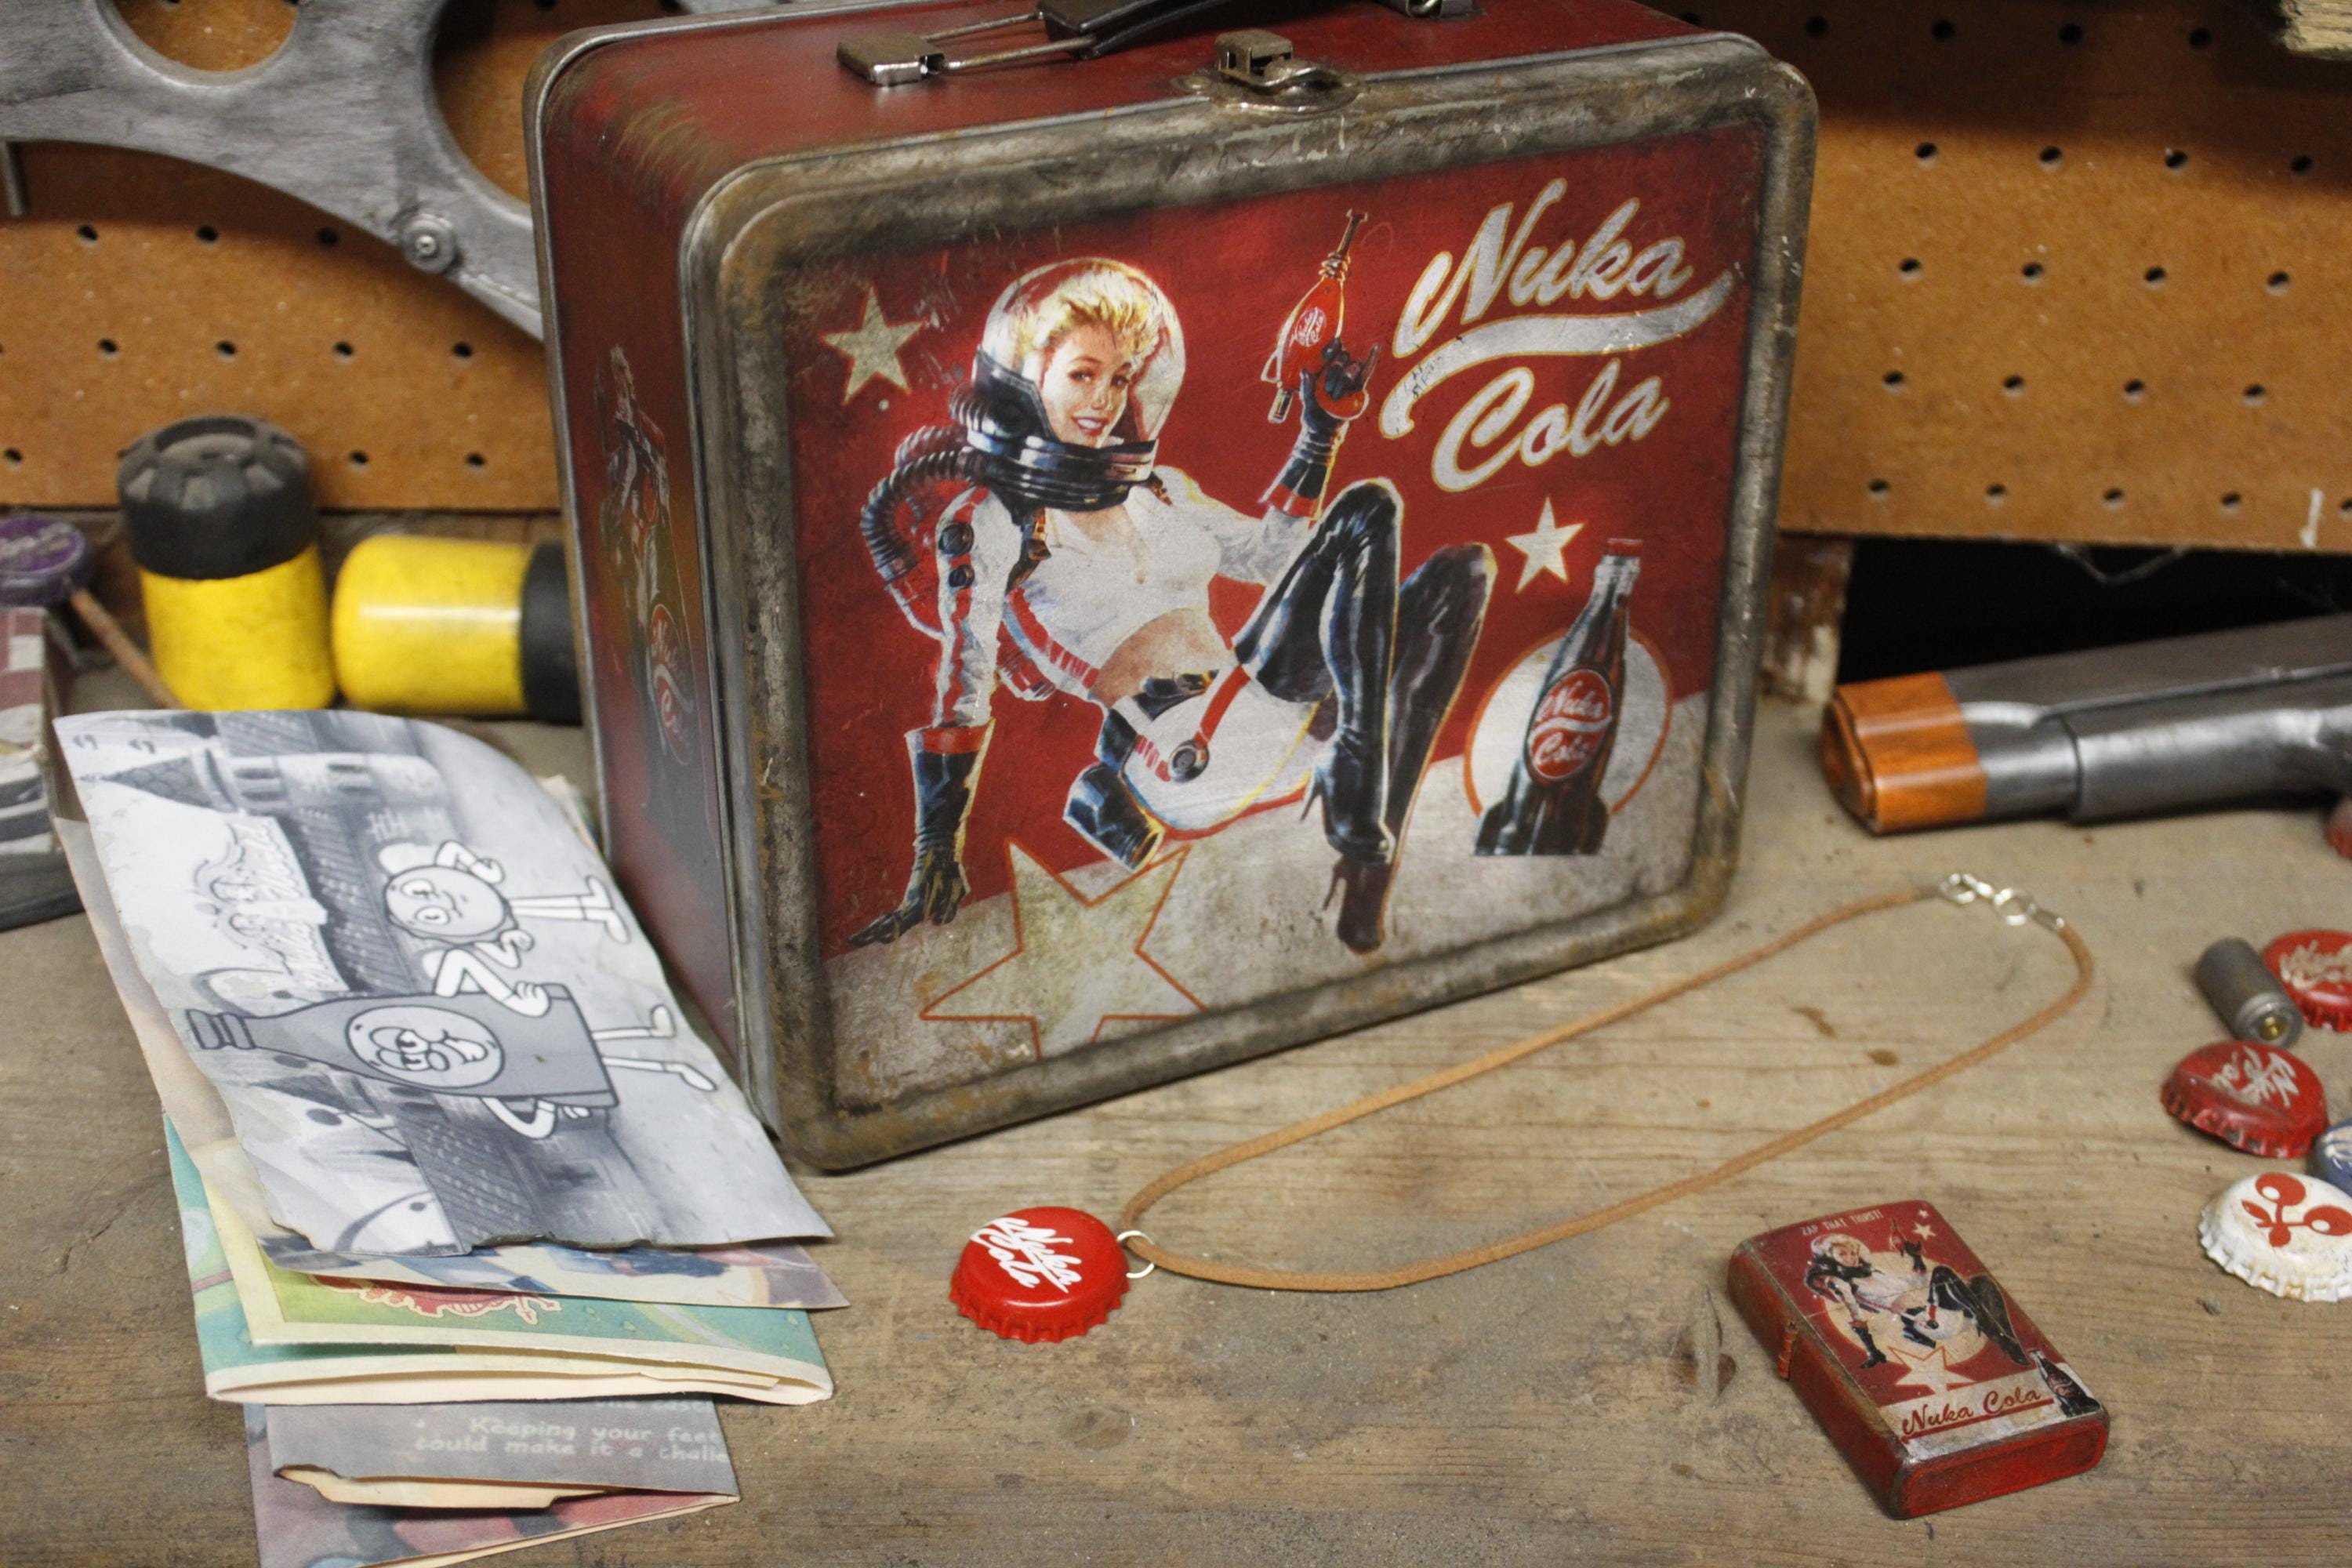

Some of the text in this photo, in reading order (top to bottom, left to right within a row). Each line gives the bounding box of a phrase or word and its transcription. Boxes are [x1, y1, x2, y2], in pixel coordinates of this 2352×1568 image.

[1392, 177, 1693, 358] Nuka
[1431, 358, 1671, 493] Cola
[1534, 680, 1603, 722] Nuka
[470, 1417, 576, 1441] Keeping
[591, 1426, 653, 1445] your
[1902, 1403, 1974, 1435] Nuka
[1983, 1386, 2042, 1414] Cola
[414, 1436, 488, 1453] could
[505, 1439, 577, 1455] make
[629, 1446, 644, 1459] a
